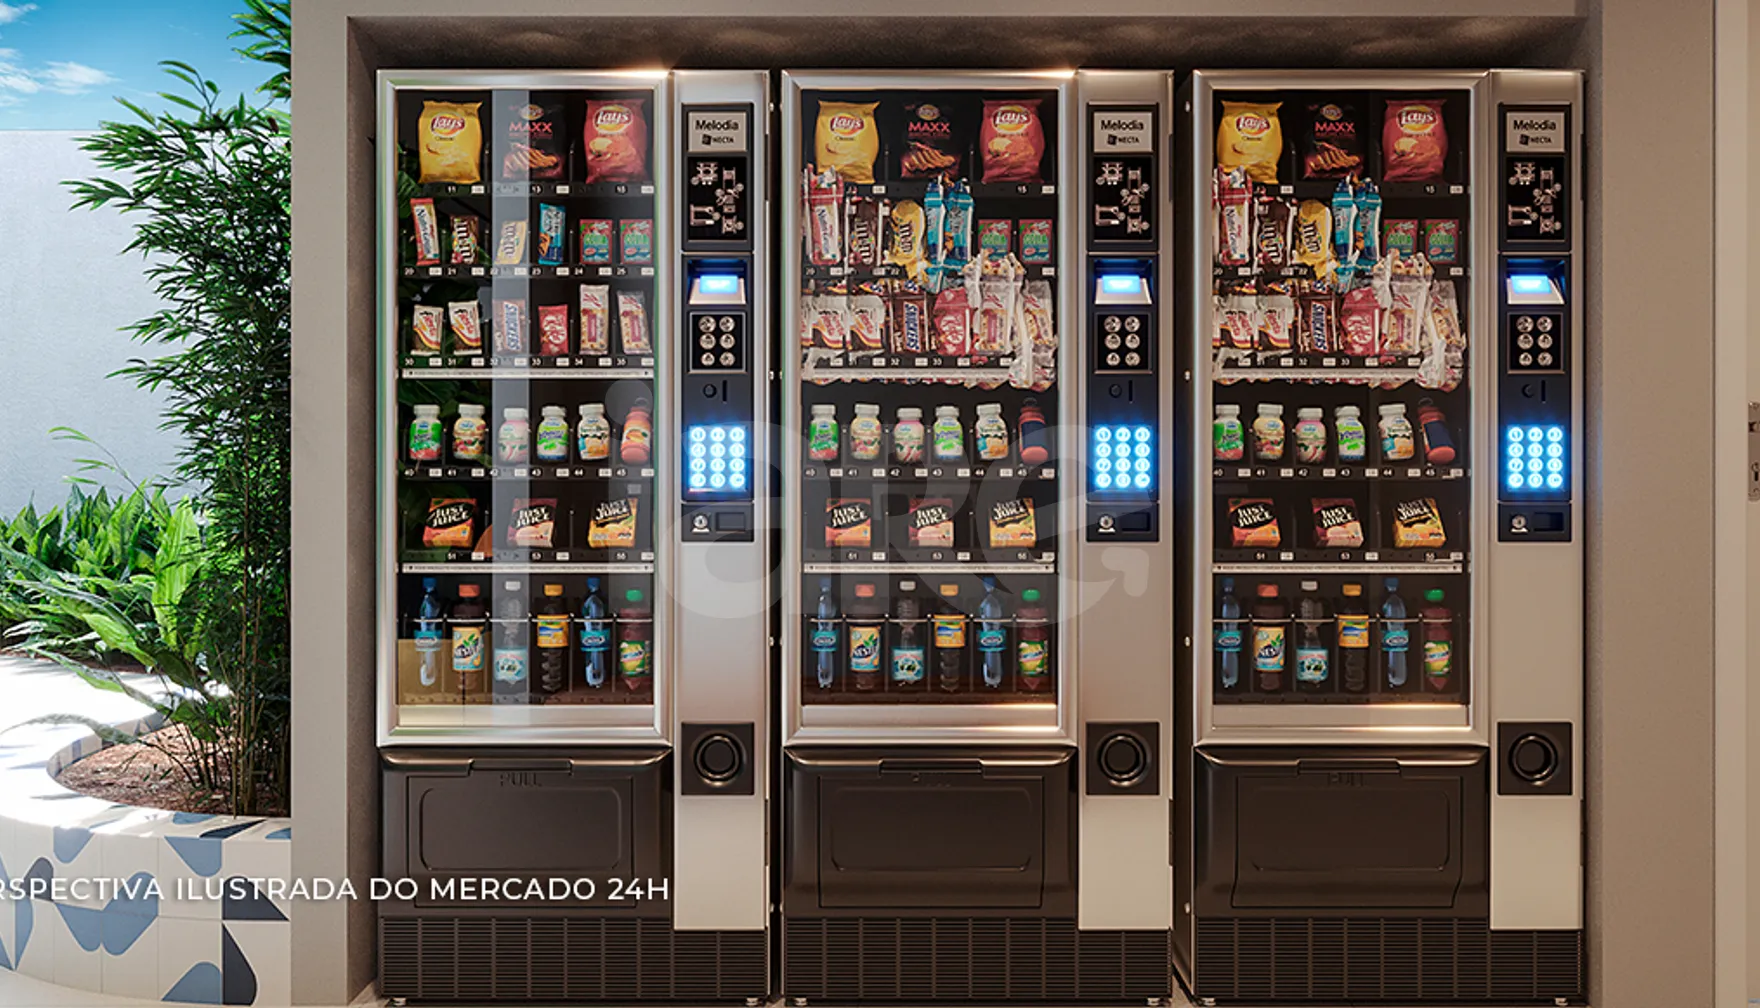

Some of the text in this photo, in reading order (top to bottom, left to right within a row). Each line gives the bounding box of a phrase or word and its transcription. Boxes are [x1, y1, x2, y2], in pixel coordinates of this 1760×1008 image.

[509, 121, 553, 132] MAXX
[695, 119, 740, 131] Melodia
[908, 121, 951, 132] MAXX
[1100, 119, 1145, 131] Melodia
[1314, 121, 1356, 132] MAXX
[1513, 119, 1557, 131] Melodia
[505, 303, 520, 350] SNICKERS
[905, 304, 920, 351] SNICKERS
[1312, 303, 1327, 350] SNICKERS
[435, 503, 464, 517] JUST
[519, 506, 547, 519] JUST
[833, 503, 864, 517] JUST
[916, 506, 945, 519] JUST
[1238, 503, 1265, 517] JUST
[1321, 506, 1347, 519] JUST
[432, 511, 469, 527] JUICE
[516, 514, 550, 528] JUICE
[832, 511, 867, 527] JUICE
[916, 513, 949, 528] JUICE
[1239, 511, 1273, 527] JUICE
[1323, 513, 1355, 528] JUICE
